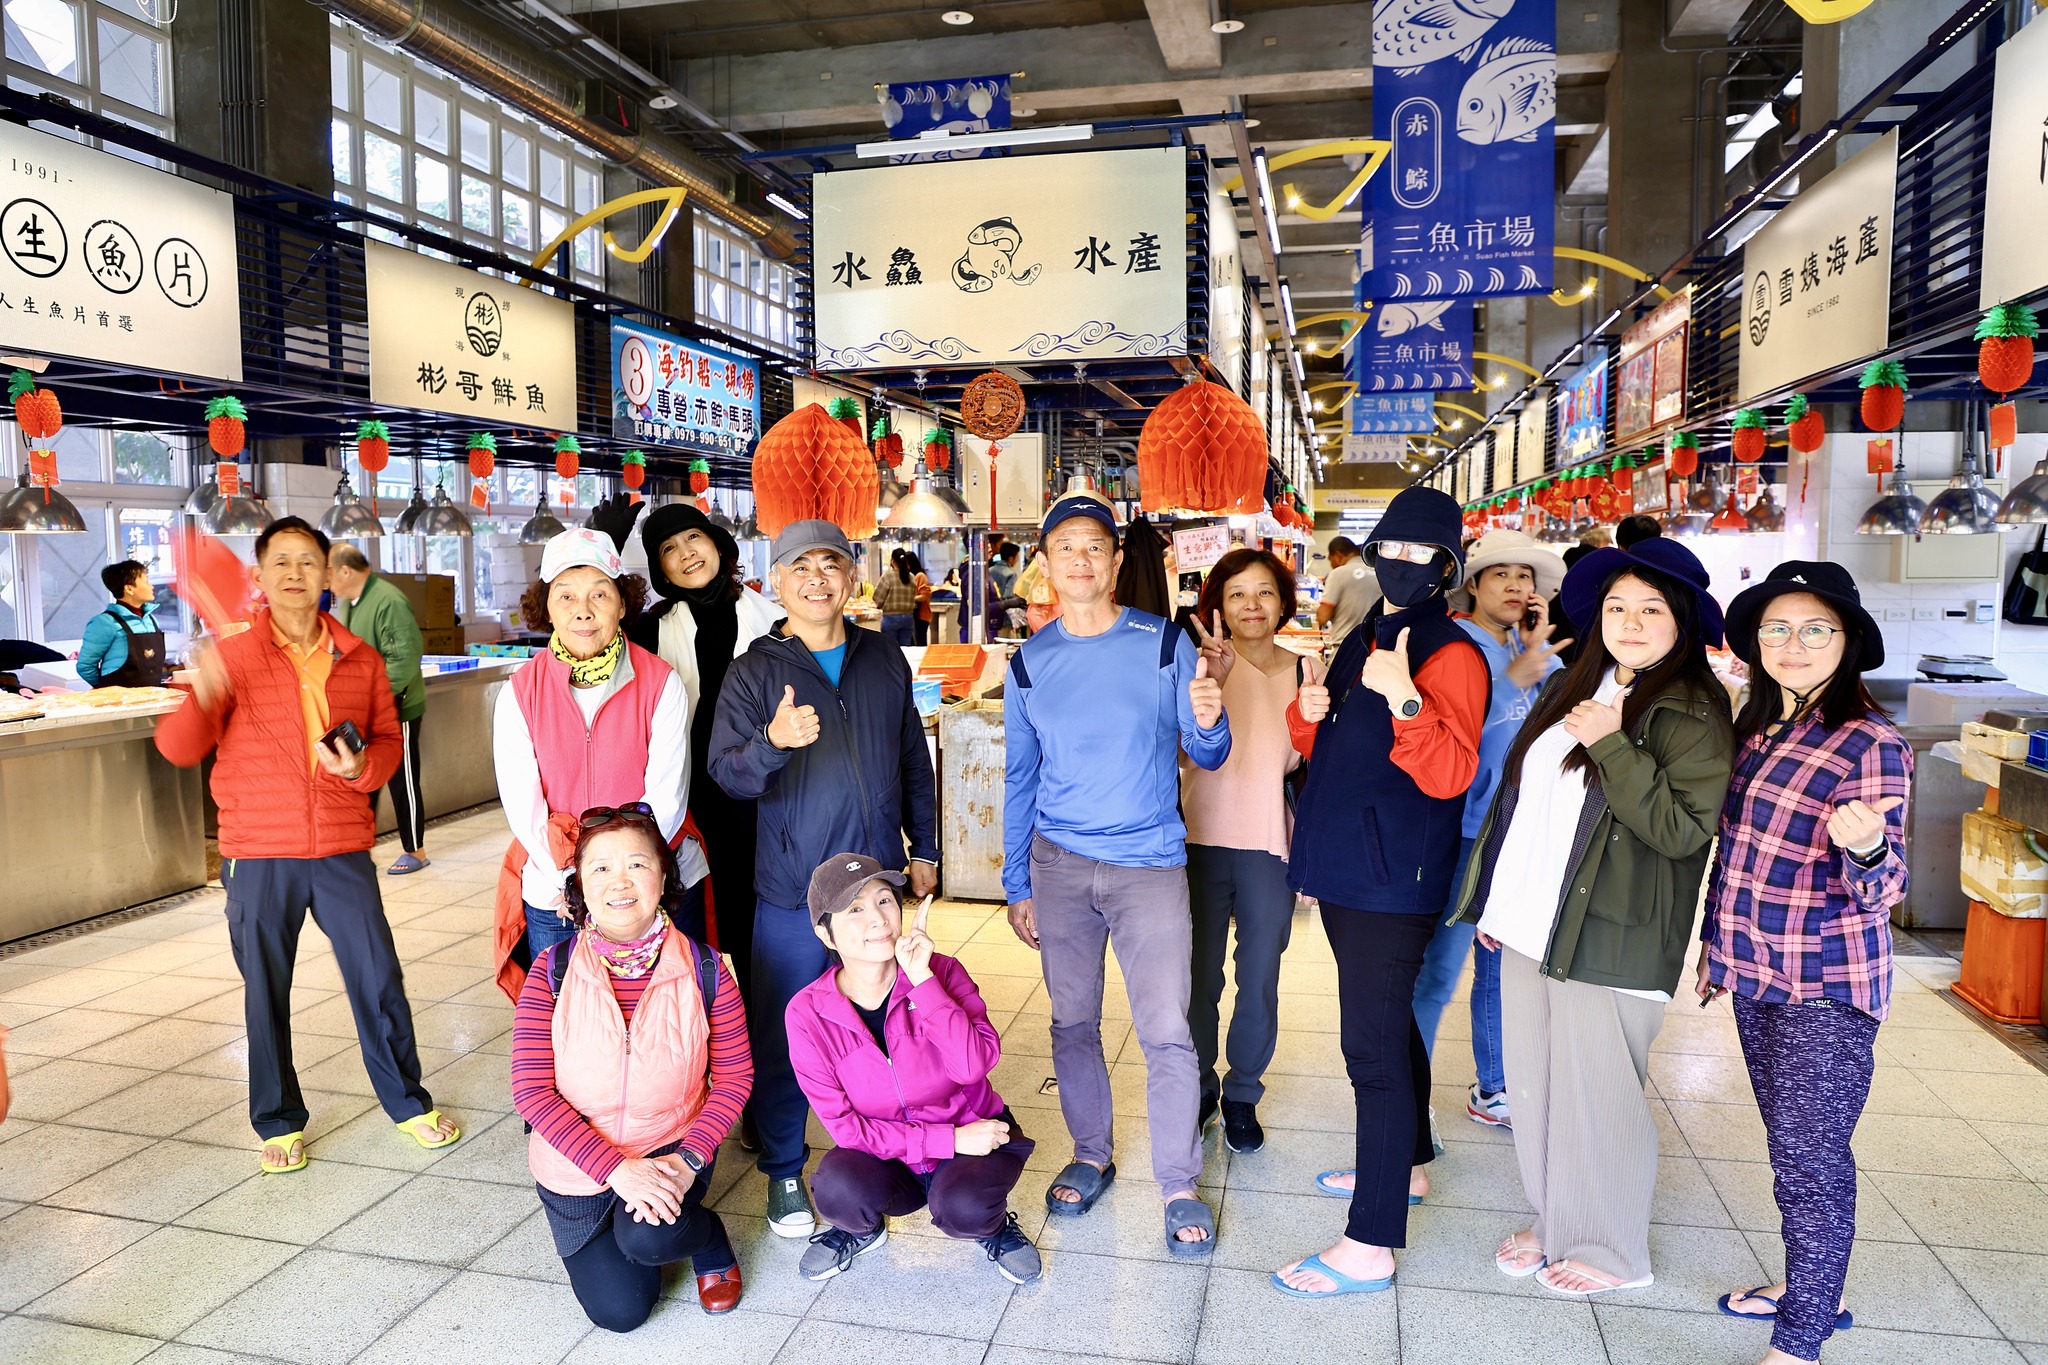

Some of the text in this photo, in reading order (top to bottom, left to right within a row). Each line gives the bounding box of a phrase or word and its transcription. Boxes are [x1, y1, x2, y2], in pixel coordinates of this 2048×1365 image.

[1405, 113, 1429, 191] 赤鯮
[14, 213, 192, 297] 生魚片
[1390, 215, 1535, 254] 三魚市場
[832, 246, 923, 289] 水鱻
[1074, 231, 1162, 275] 水產
[1779, 215, 1879, 306] 雪姨海產
[474, 302, 494, 325] 彬
[1807, 302, 1824, 318] SINCE
[629, 347, 645, 396] 3
[1372, 341, 1462, 363] 三魚市場
[416, 361, 547, 414] 彬哥鮮魚
[1361, 397, 1426, 413] 三魚市場
